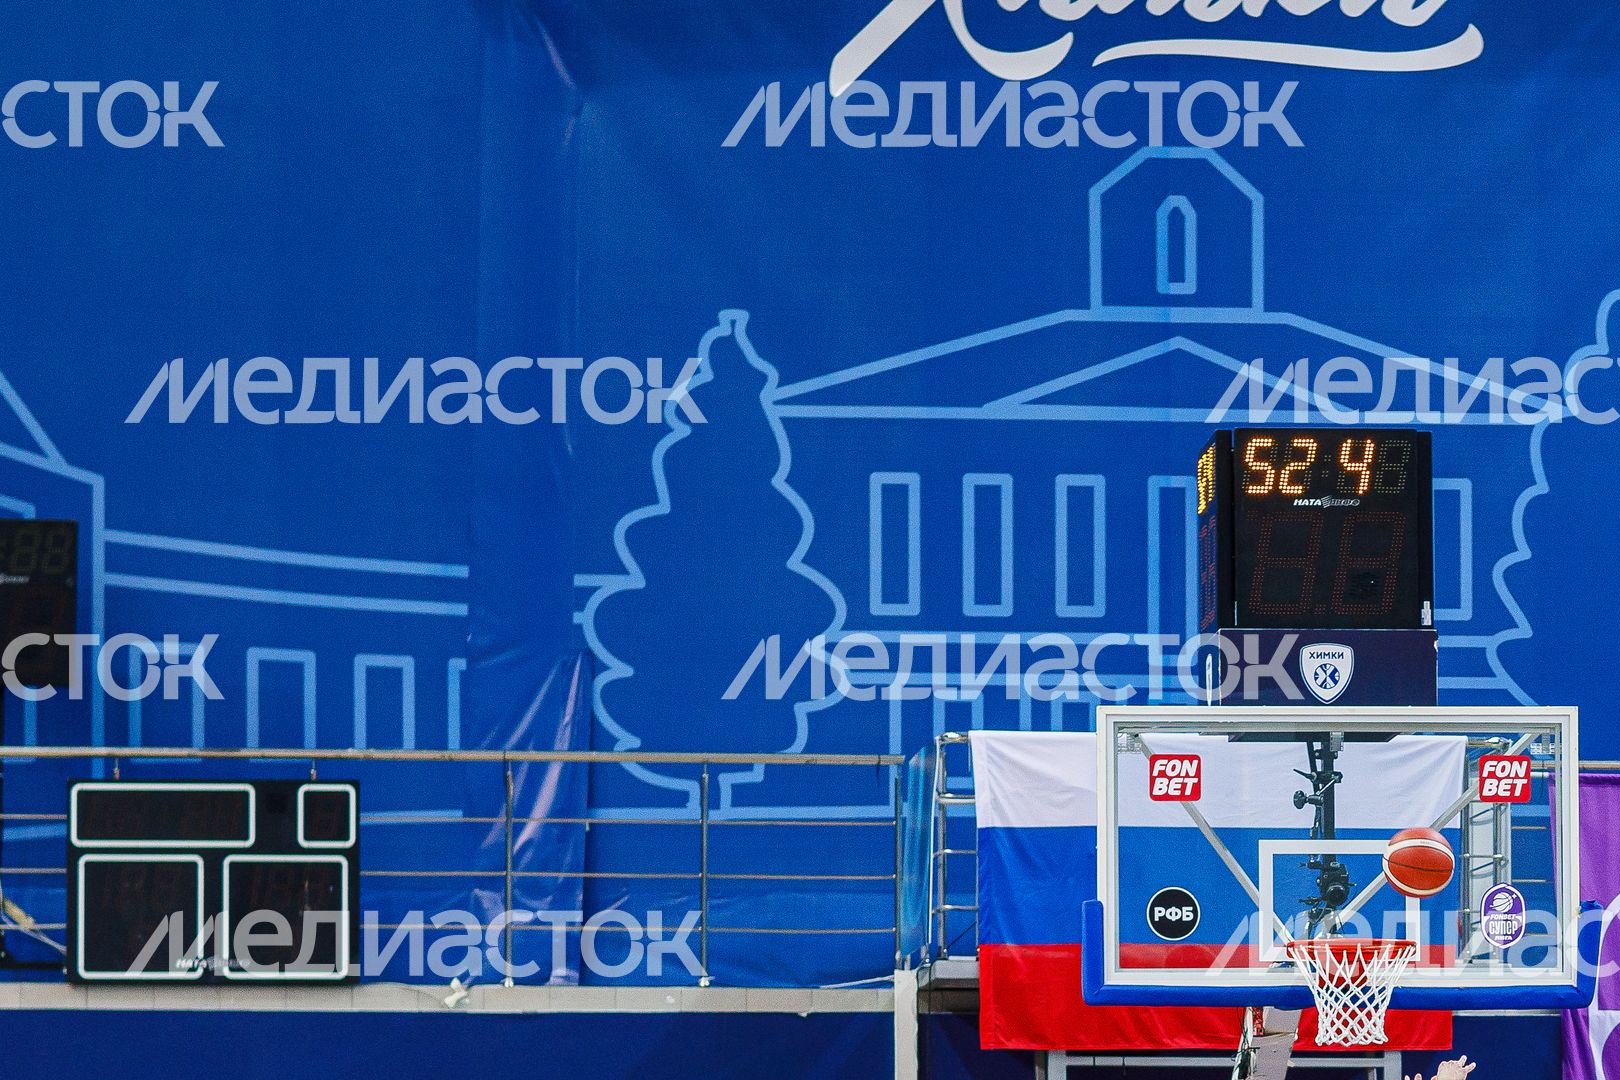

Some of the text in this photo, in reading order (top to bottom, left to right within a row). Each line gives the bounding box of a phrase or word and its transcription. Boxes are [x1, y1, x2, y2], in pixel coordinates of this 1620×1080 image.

[1309, 651, 1344, 660] ХИМКИ
[1152, 759, 1198, 777] FON
[1482, 760, 1528, 778] FON
[1152, 777, 1198, 796] BET
[1482, 778, 1528, 797] BET
[1154, 906, 1194, 922] РФБ
